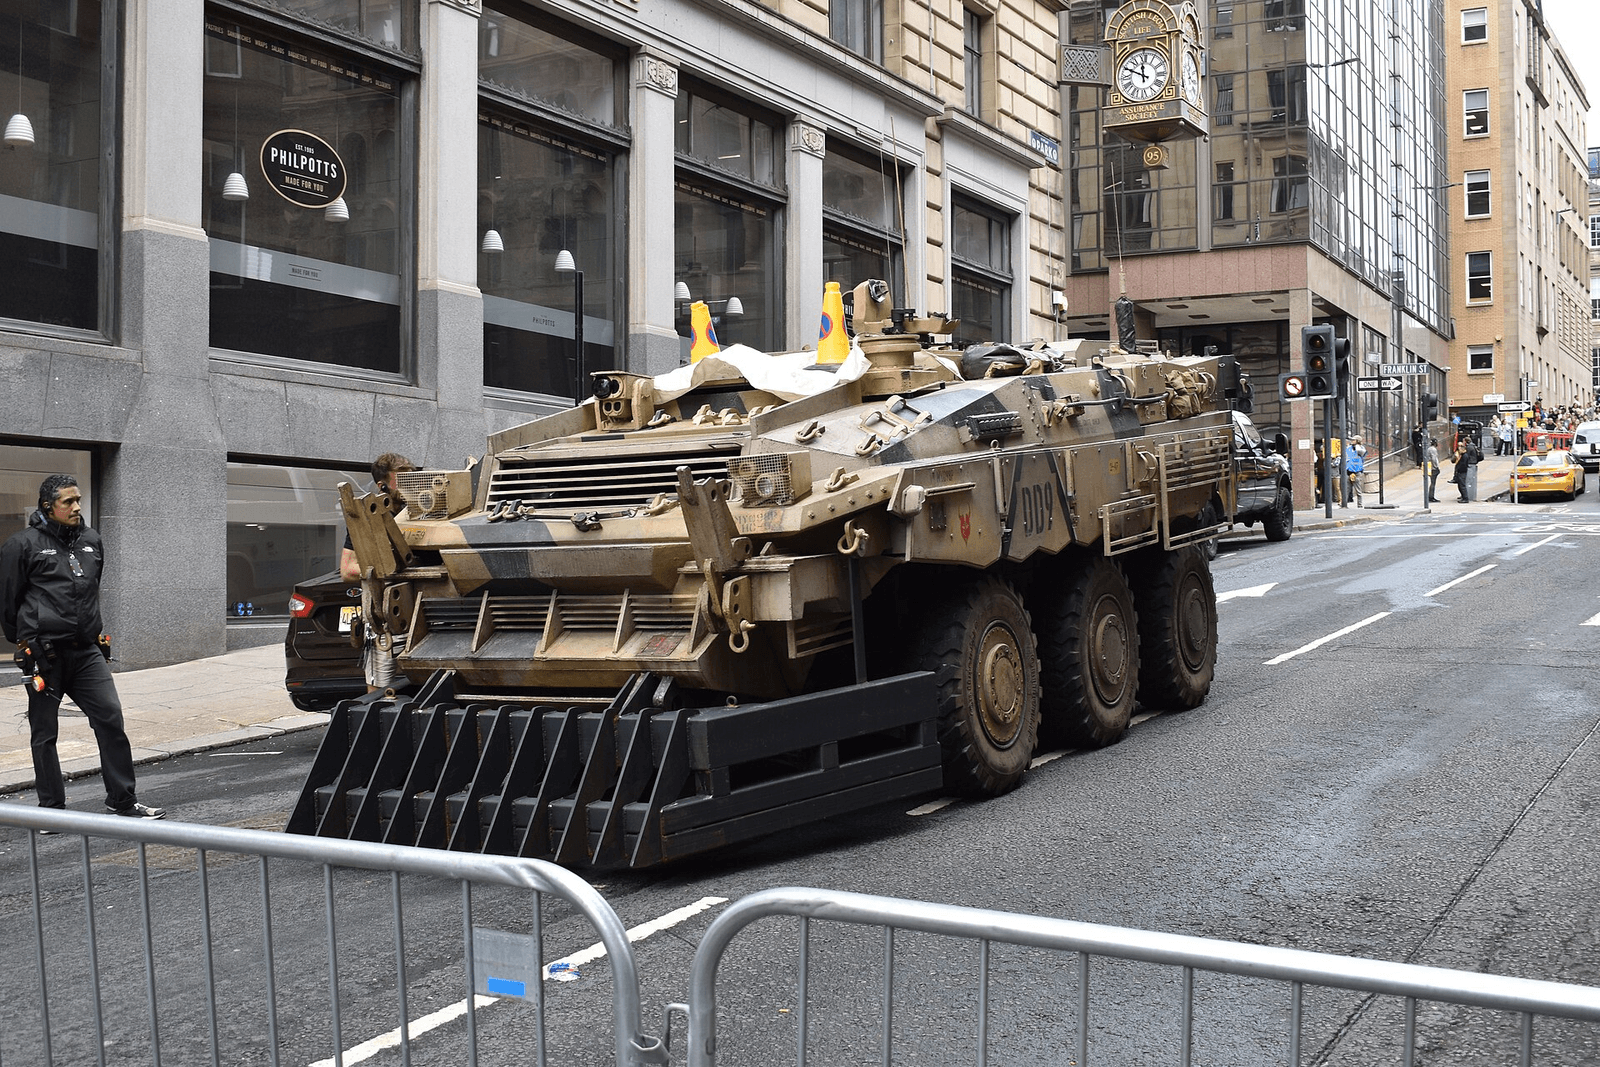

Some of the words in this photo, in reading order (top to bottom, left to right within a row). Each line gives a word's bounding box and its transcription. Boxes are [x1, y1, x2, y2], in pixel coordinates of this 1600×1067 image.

[1119, 12, 1146, 39] SCOTTISH
[1148, 12, 1167, 33] LEGAL
[1133, 26, 1152, 35] LIFE
[1119, 102, 1165, 115] ASSURANCE
[1125, 110, 1159, 121] SOCIETY
[1147, 151, 1159, 161] 95
[271, 147, 338, 179] PHILPOTTS
[285, 175, 300, 188] MADE
[301, 179, 312, 191] FOR
[313, 182, 324, 193] YOU
[291, 267, 302, 275] MADE
[1383, 365, 1417, 374] FRANKLIN
[1418, 364, 1427, 373] ST
[1022, 481, 1053, 537] DD9
